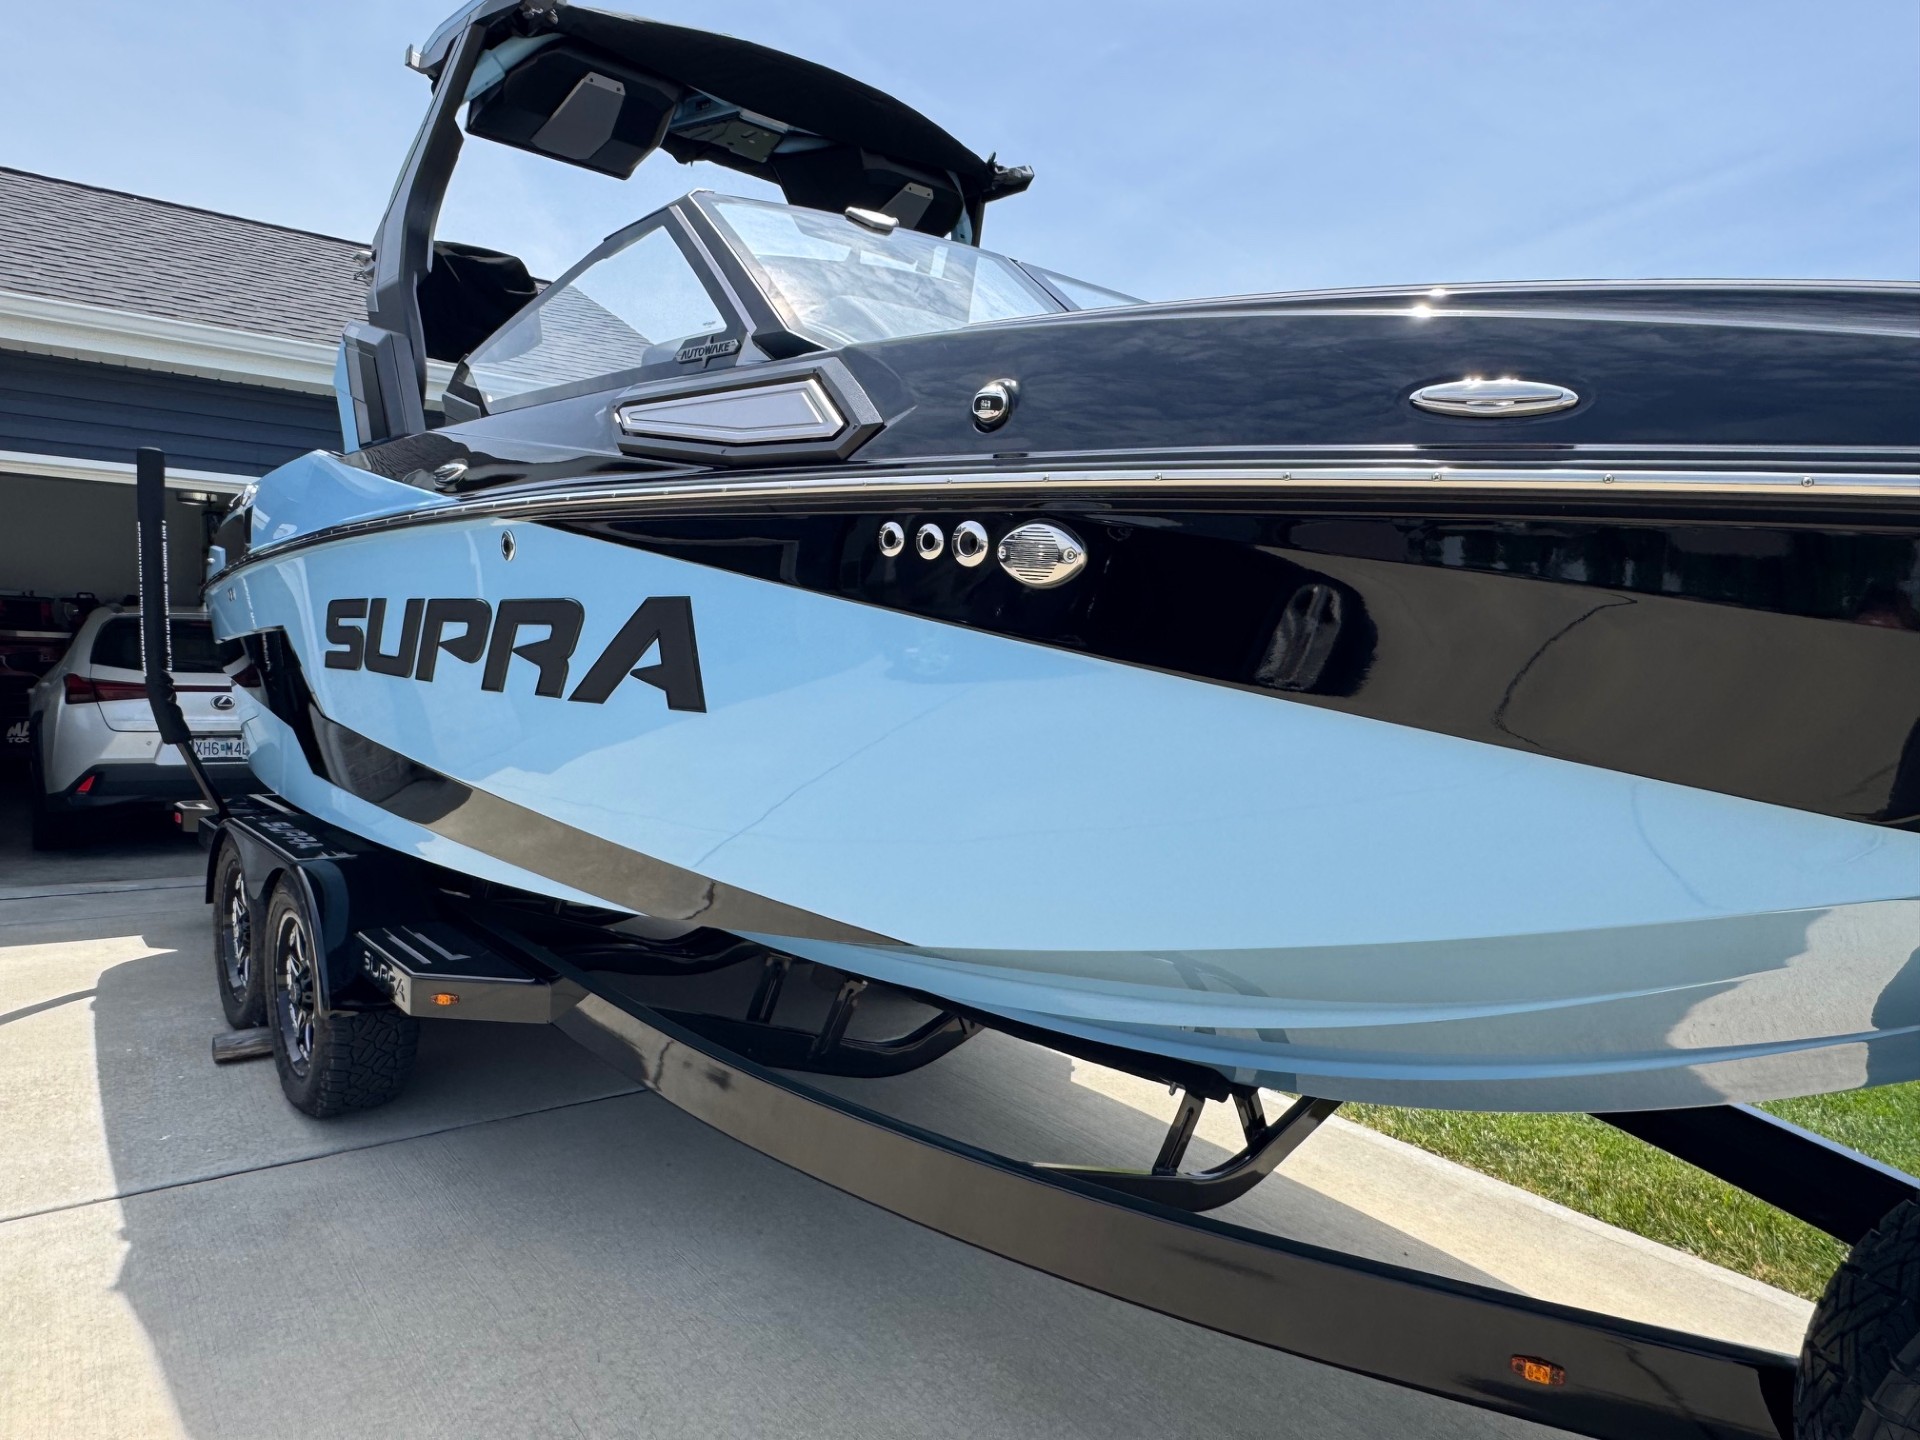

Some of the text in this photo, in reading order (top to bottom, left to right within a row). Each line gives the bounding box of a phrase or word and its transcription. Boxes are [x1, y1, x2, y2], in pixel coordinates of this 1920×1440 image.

[681, 342, 731, 361] AUTOWAKE
[324, 595, 707, 714] SUPRA
[195, 742, 219, 756] XH6
